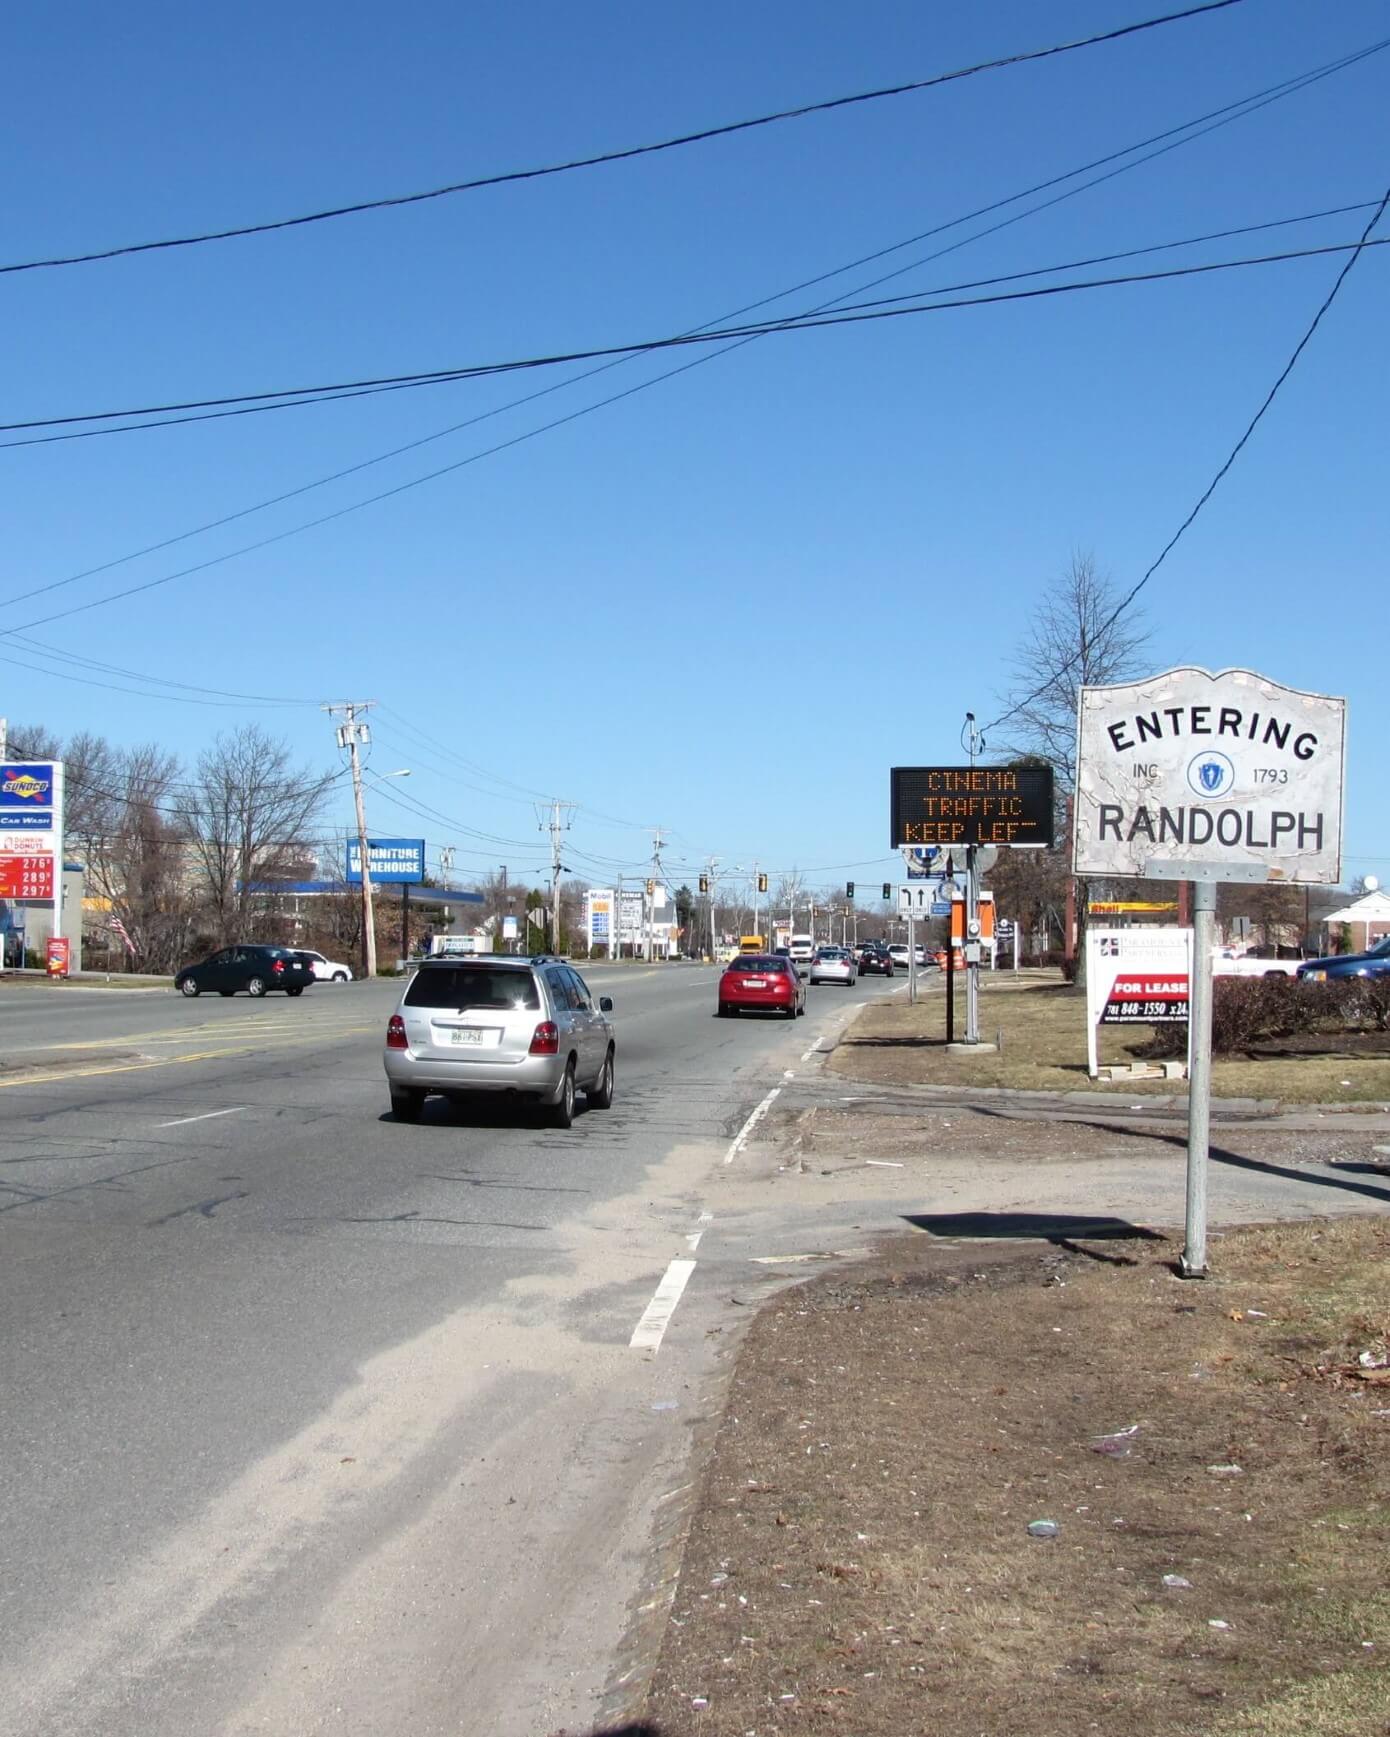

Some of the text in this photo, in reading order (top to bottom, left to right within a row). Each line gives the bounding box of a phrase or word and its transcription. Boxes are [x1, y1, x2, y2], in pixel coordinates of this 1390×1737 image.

[1107, 706, 1318, 760] ENTERING
[928, 771, 1017, 790] CINEMA
[1253, 768, 1288, 784] 1793
[3, 781, 48, 792] SUNOCO
[923, 797, 1022, 816] TRAFFIC
[905, 823, 965, 841] KEEP
[1099, 804, 1324, 850] RANDOLPH
[350, 860, 420, 873] WREHOUSE
[1091, 904, 1119, 912] Shell
[1114, 983, 1188, 993] FOR LEASE
[1121, 1002, 1166, 1015] 848-1550
